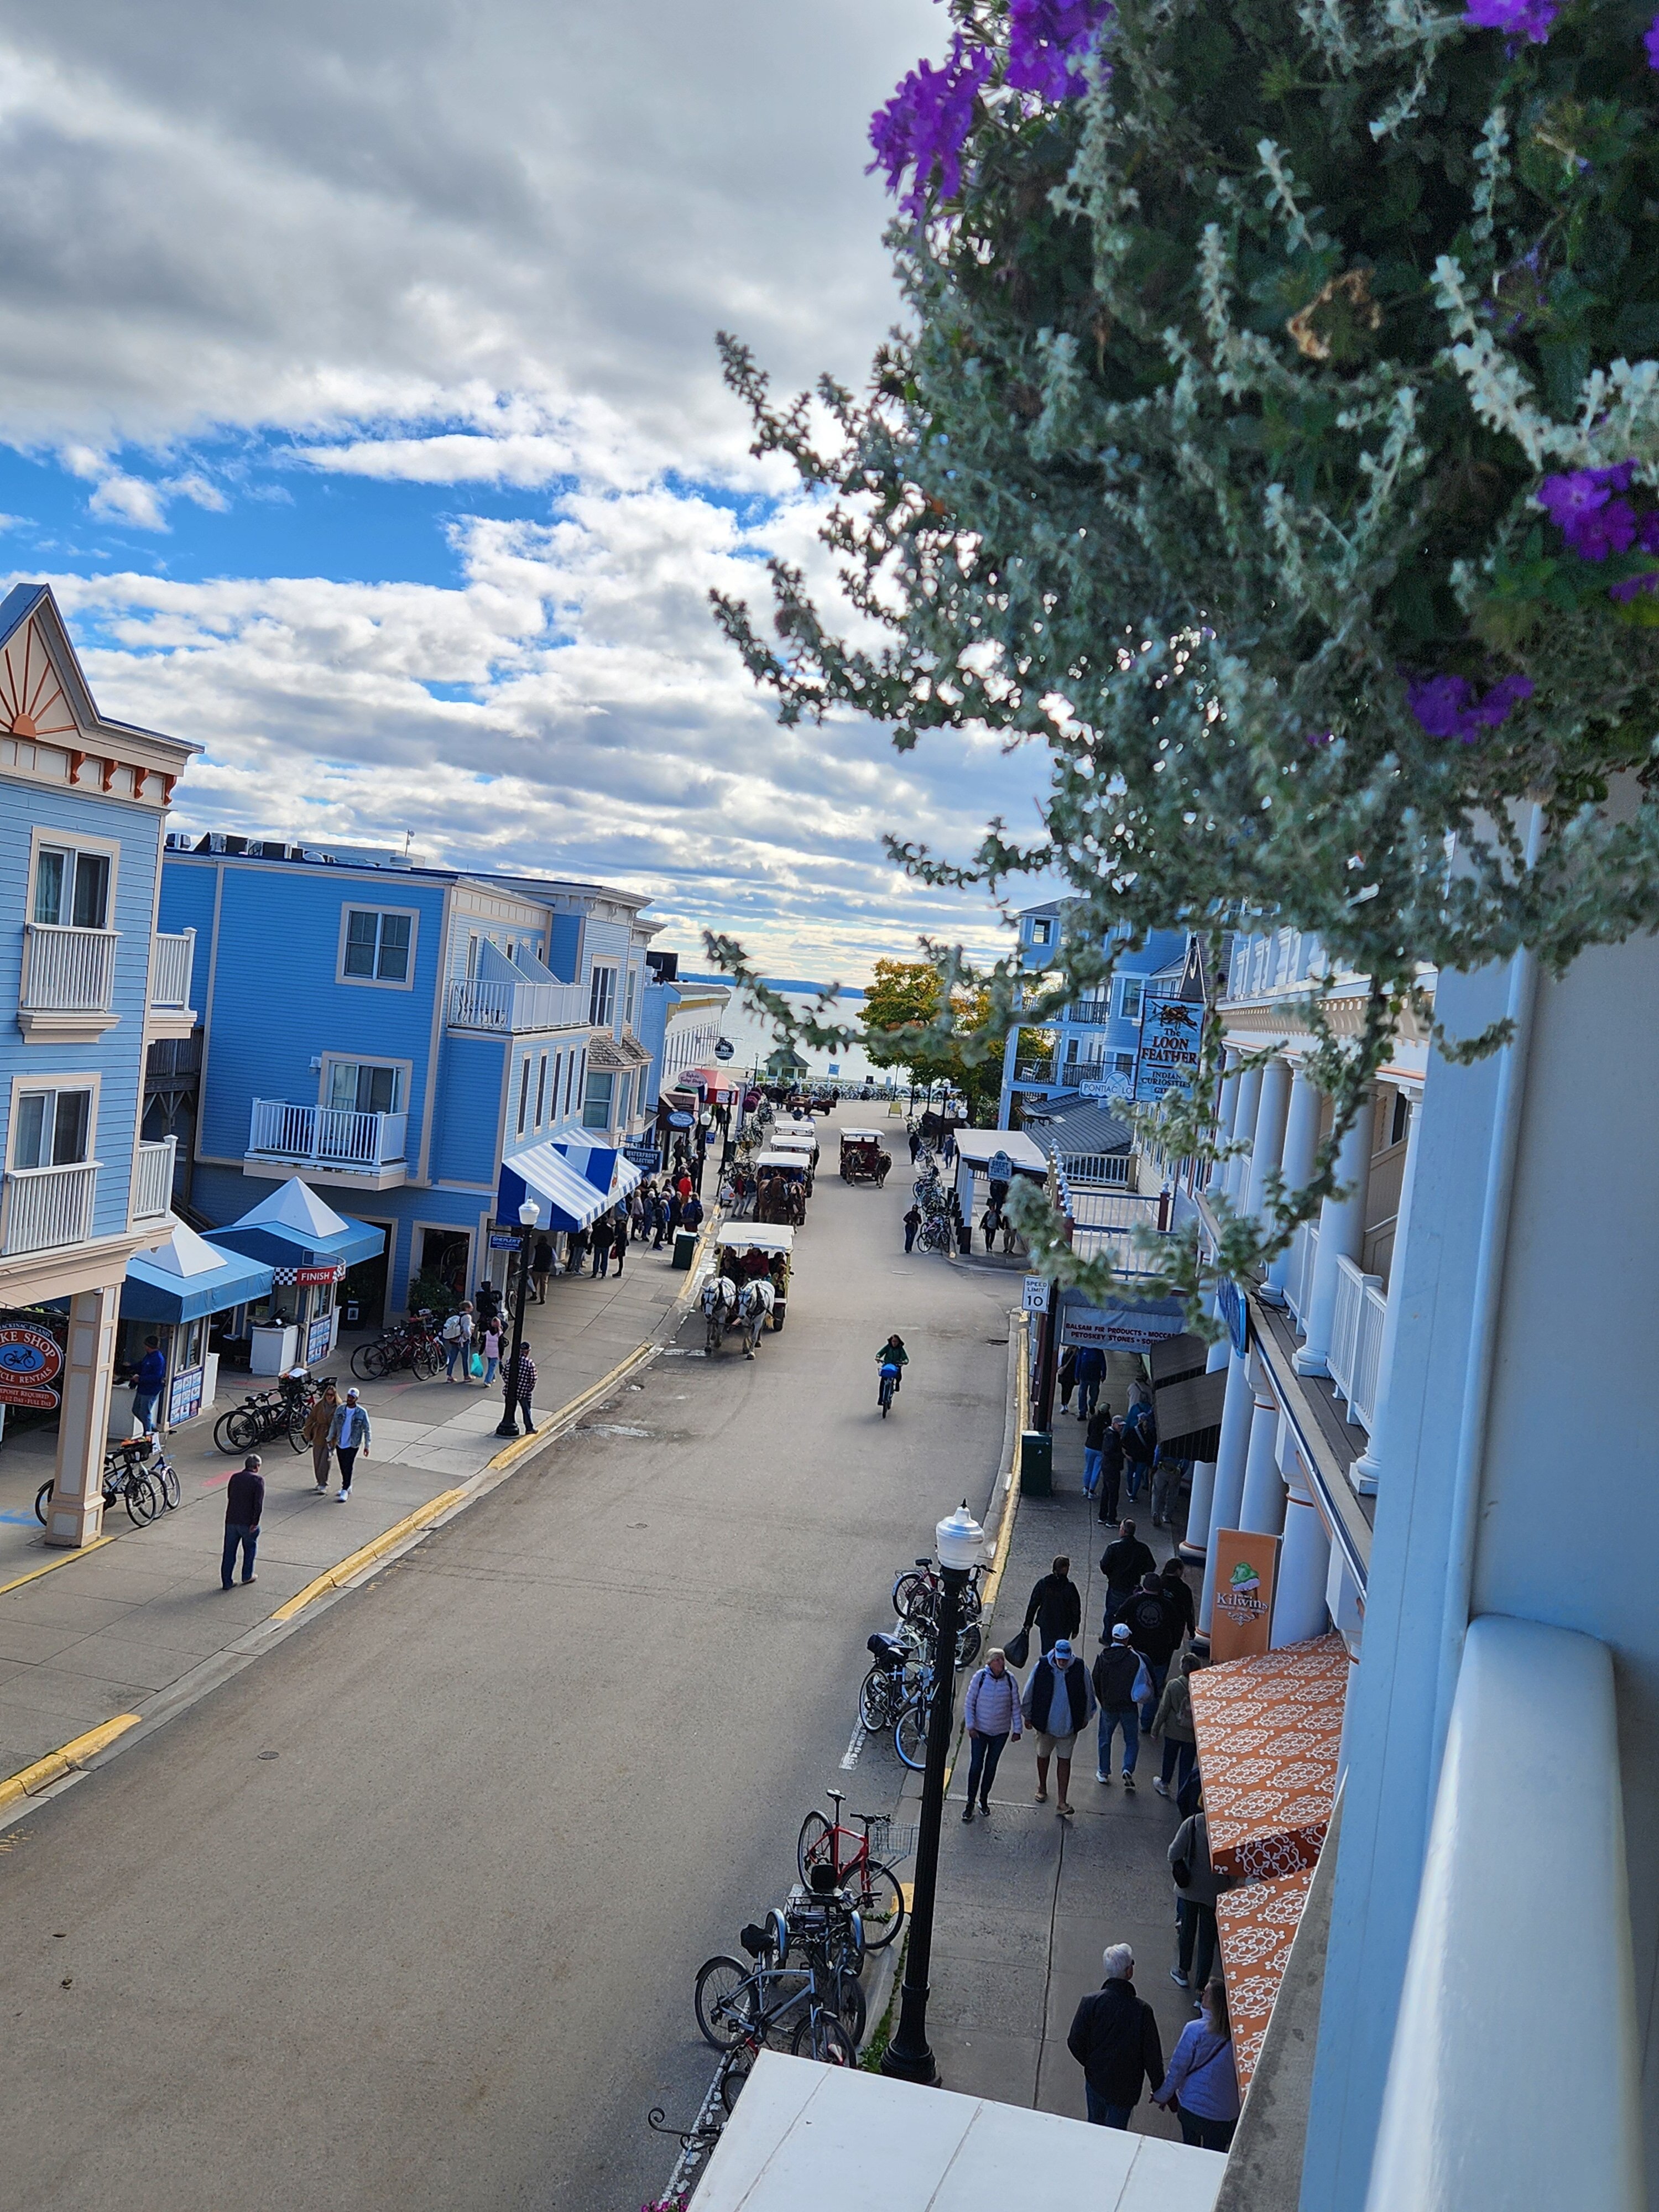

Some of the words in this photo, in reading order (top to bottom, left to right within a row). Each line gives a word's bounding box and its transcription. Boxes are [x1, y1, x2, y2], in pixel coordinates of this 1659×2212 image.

[1164, 1027, 1181, 1036] The
[1152, 1036, 1189, 1051] LOON
[1141, 1048, 1197, 1065] FEATHER
[1152, 1071, 1181, 1080] INDIAN
[1141, 1077, 1191, 1088] CURIOSITIES
[1084, 1084, 1118, 1093] PONTIAC
[301, 1272, 330, 1281] FINISH
[1027, 1295, 1043, 1306] 10
[29, 1325, 50, 1337] ISLAND
[1071, 1331, 1106, 1340] PETOSKEY
[1108, 1327, 1142, 1335] PRODUCTS
[0, 1331, 18, 1343] KE
[23, 1332, 56, 1357] SHOP
[0, 1371, 15, 1382] CLE
[19, 1366, 53, 1383] RENTALS
[20, 1391, 50, 1399] REQUIRED
